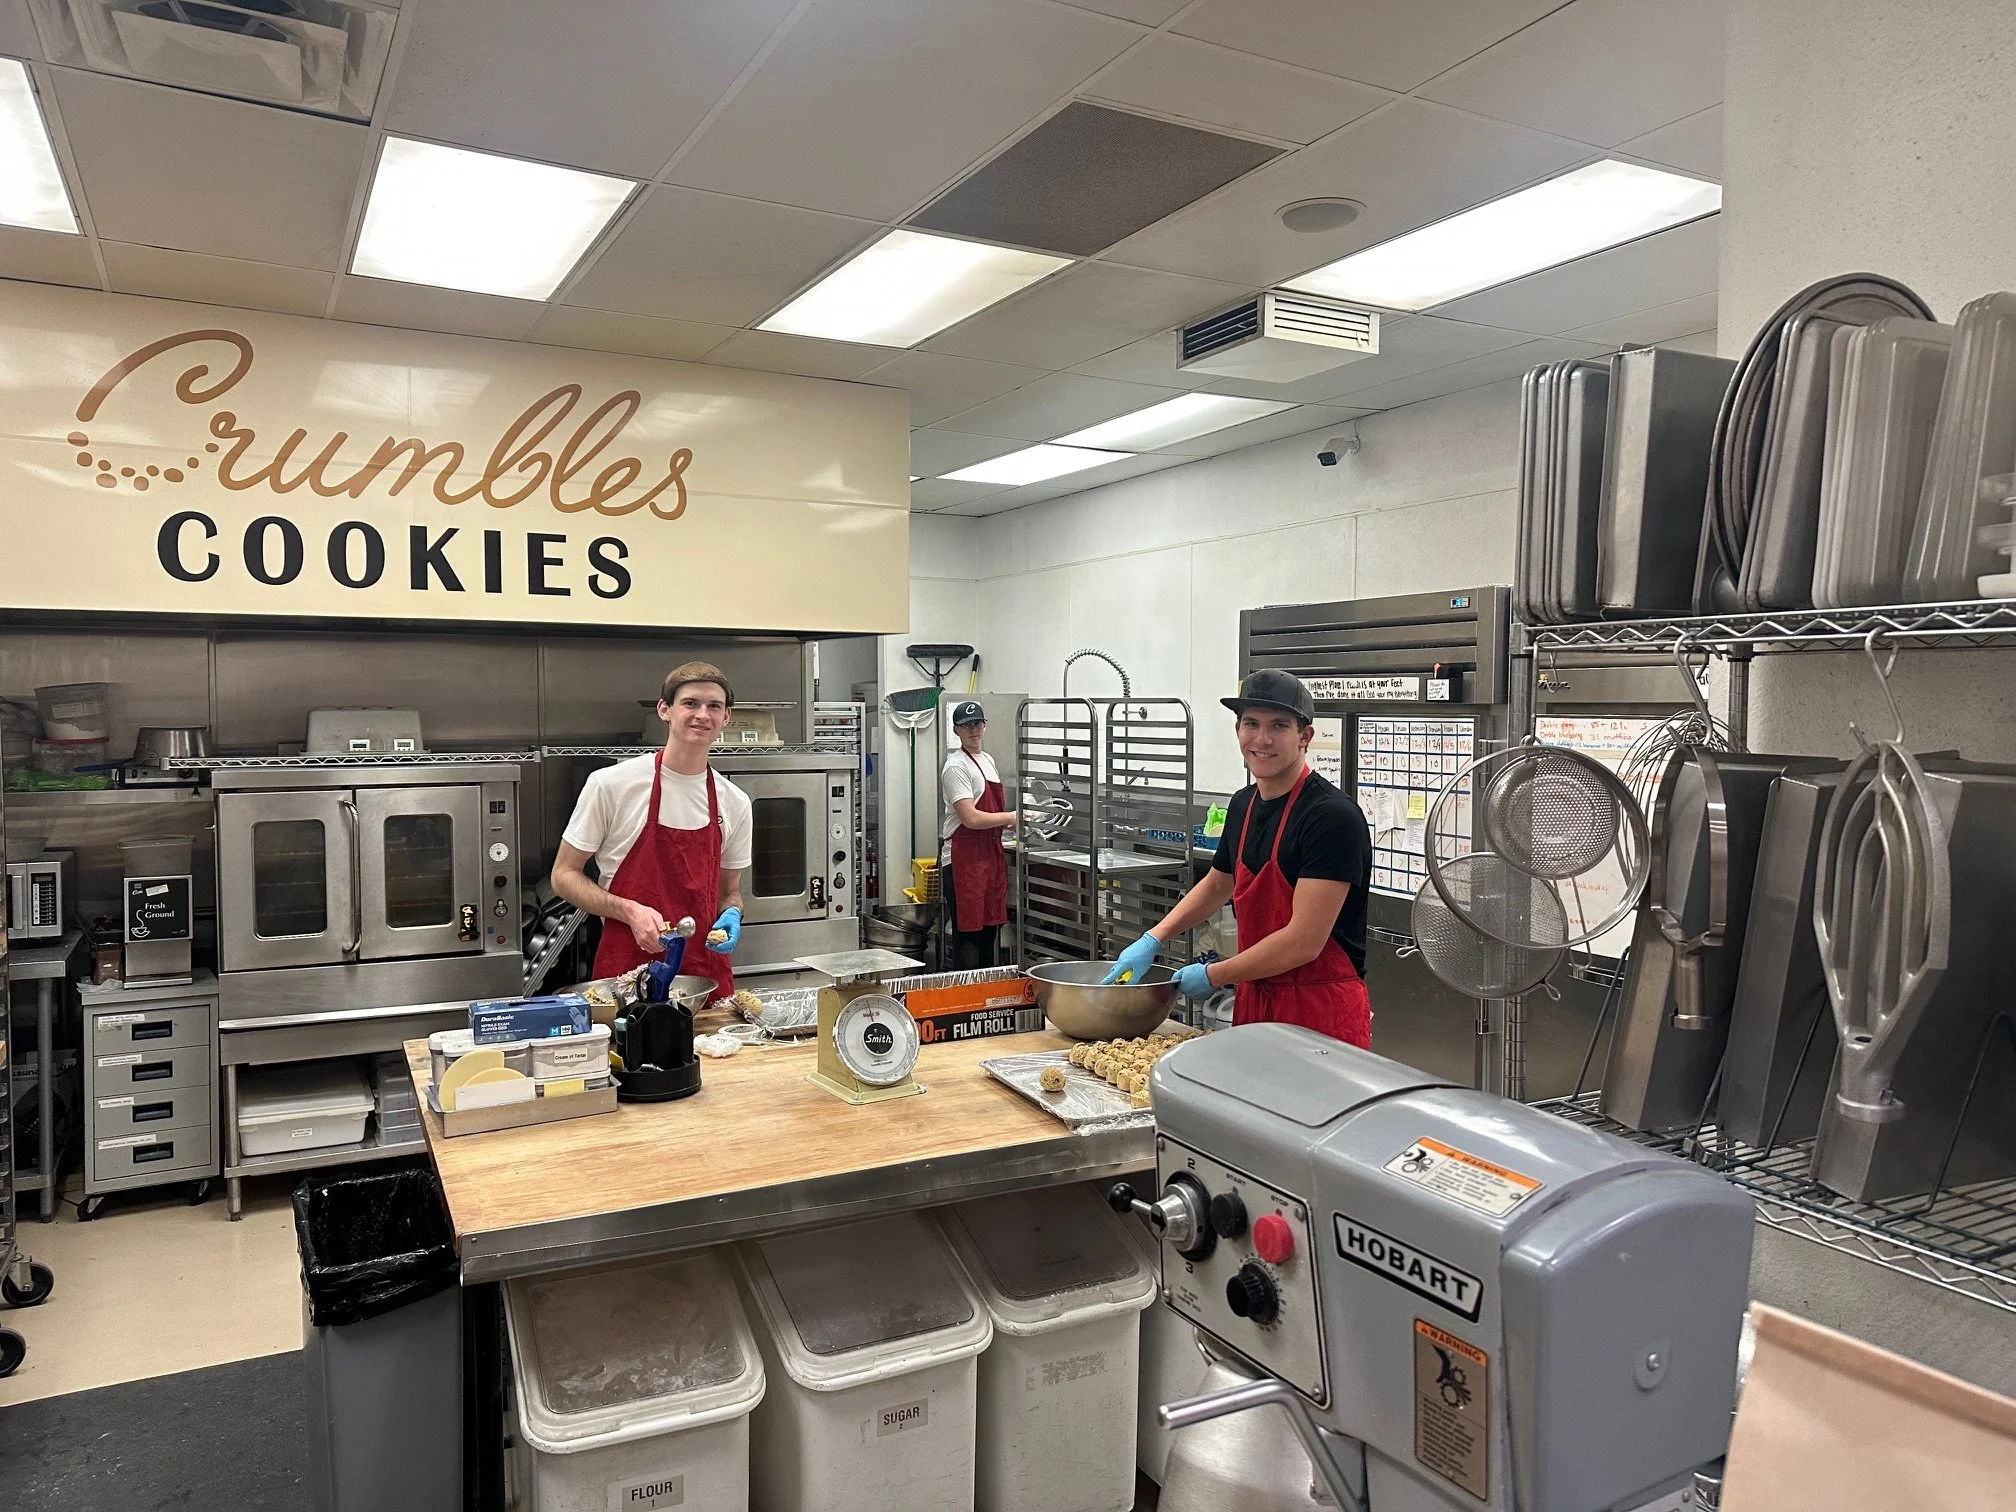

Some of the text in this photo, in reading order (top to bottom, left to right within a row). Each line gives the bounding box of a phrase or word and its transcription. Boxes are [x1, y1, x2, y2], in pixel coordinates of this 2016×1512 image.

[67, 329, 693, 520] Crumbles
[157, 510, 633, 599] COOKIES
[1357, 690, 1366, 698] all
[966, 704, 976, 714] C
[144, 902, 166, 910] Fresh
[144, 910, 174, 918] Ground
[480, 1014, 514, 1022] DuraBasic
[970, 1008, 1014, 1020] FOOD SERVICE
[953, 1021, 982, 1039] FILM
[984, 1017, 1014, 1034] ROLL
[866, 1034, 892, 1044] Smith
[1188, 1157, 1196, 1170] 2
[1463, 1155, 1508, 1176] WARNING
[1226, 1173, 1246, 1185] START
[1270, 1194, 1288, 1206] STOP
[1186, 1262, 1194, 1274] 3
[1348, 1228, 1468, 1300] HOBART
[1430, 1330, 1481, 1361] WARNING
[884, 1406, 920, 1426] SUGAR
[630, 1481, 673, 1502] FLOUR
